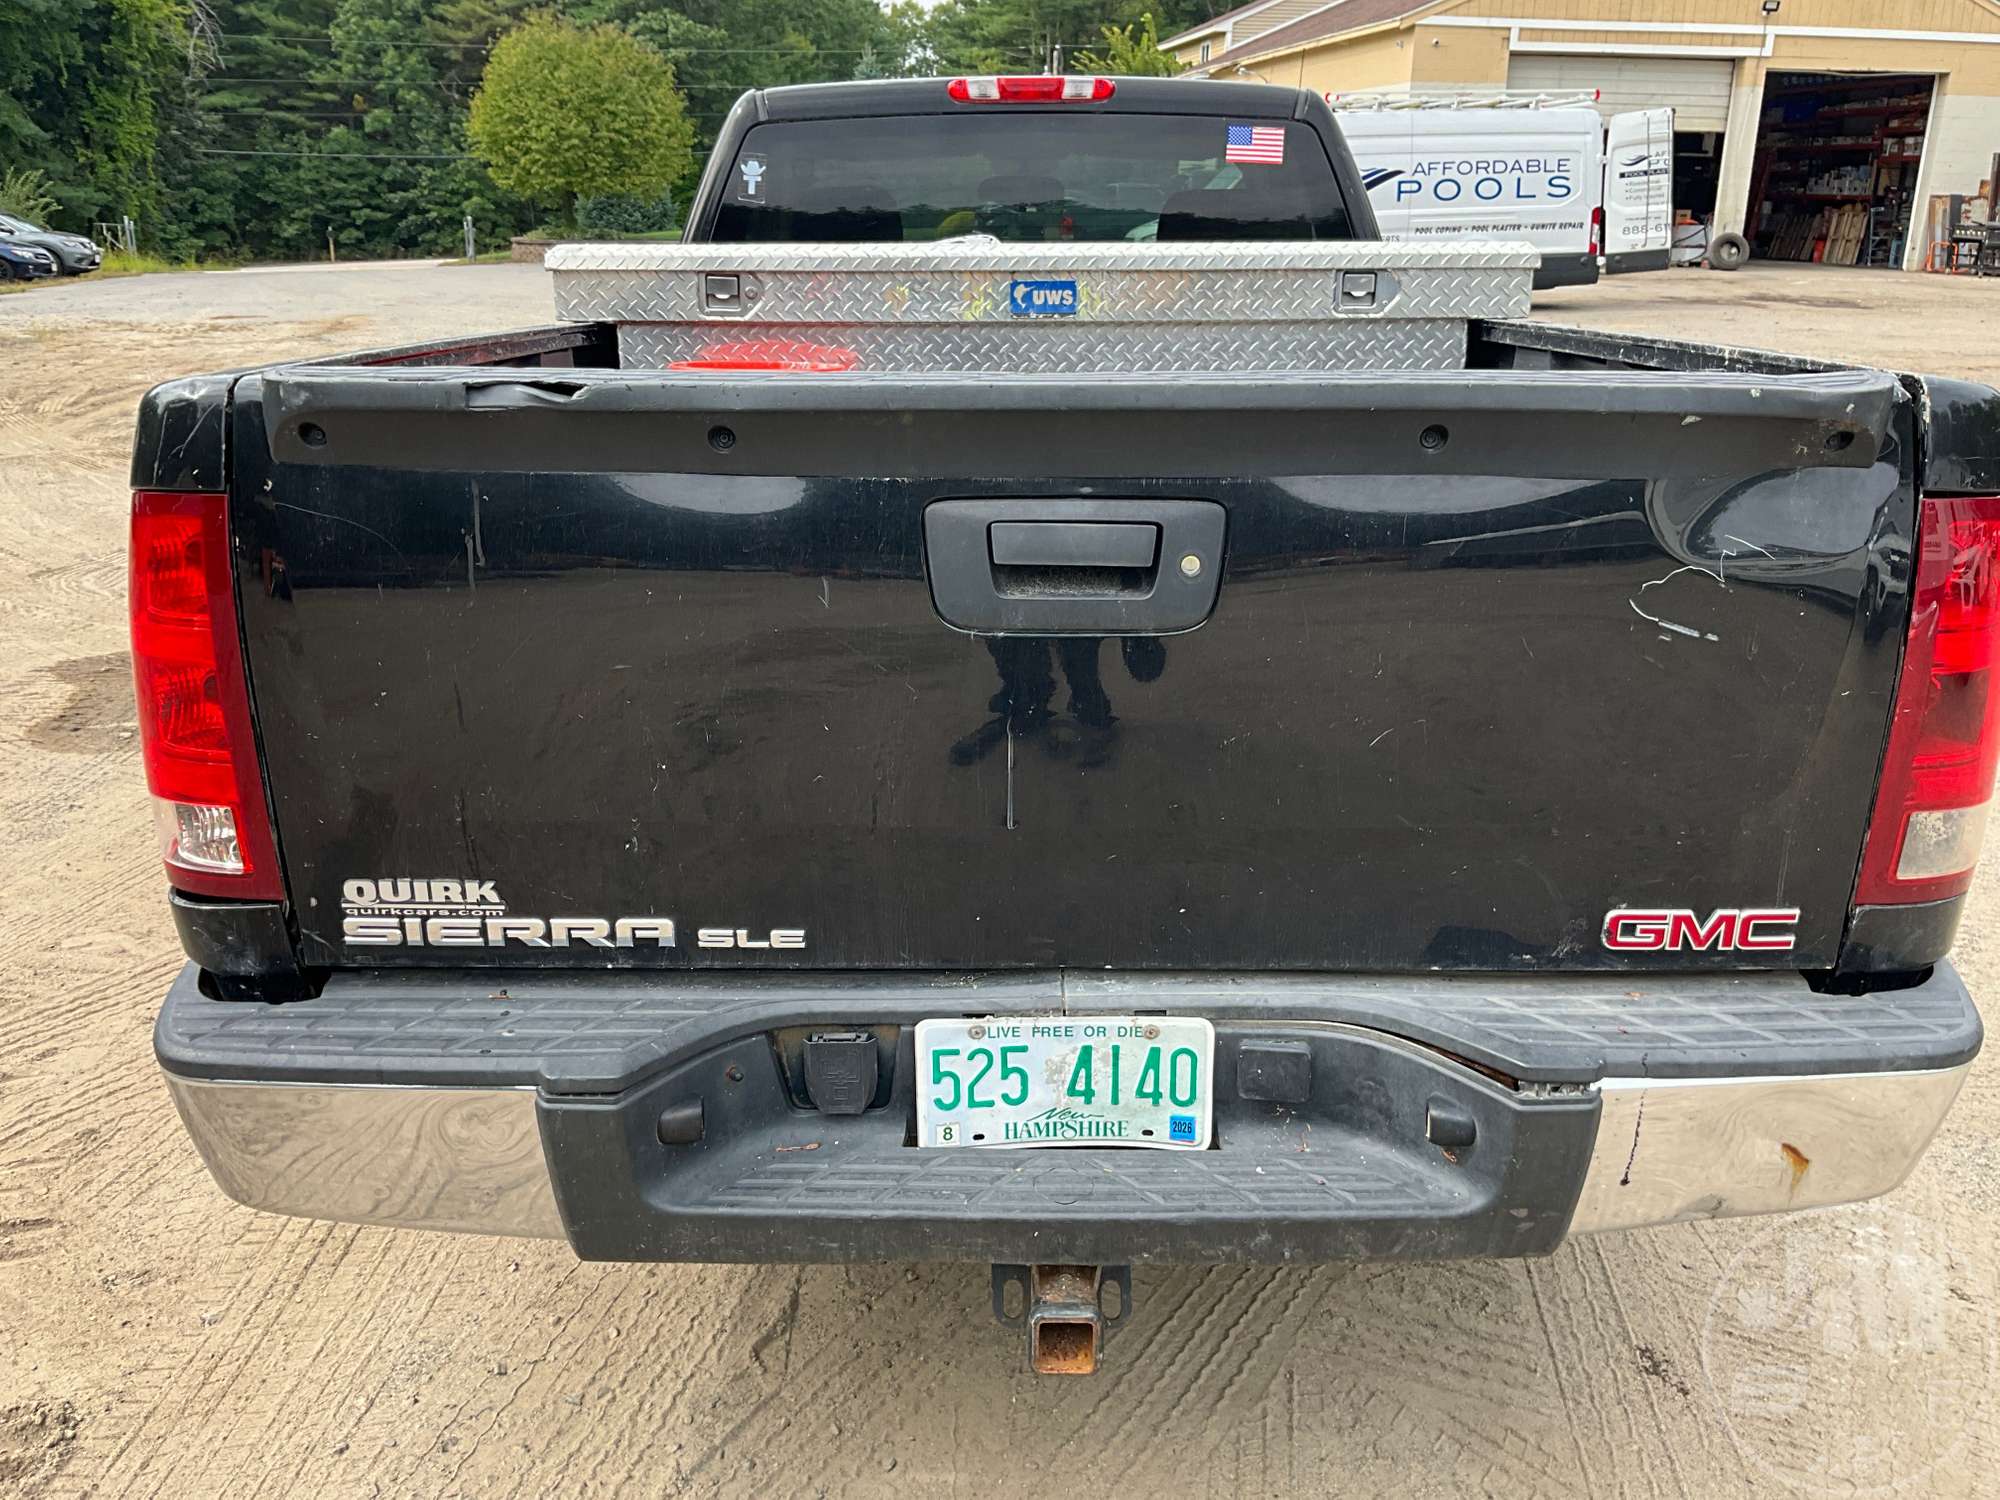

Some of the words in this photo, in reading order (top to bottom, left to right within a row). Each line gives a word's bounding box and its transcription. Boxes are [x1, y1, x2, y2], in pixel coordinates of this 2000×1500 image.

[1412, 158, 1571, 177] AFFORDABLE
[1396, 175, 1571, 202] POOLS
[1415, 226, 1433, 235] POOL
[1471, 224, 1490, 233] POOL
[1491, 223, 1521, 232] PLASTER
[1559, 221, 1585, 230] REPAIR
[1032, 290, 1073, 306] UWS
[343, 878, 501, 906] QUIRK
[345, 907, 504, 917] quirkcars.com
[343, 917, 675, 948] SIERRA
[697, 929, 806, 949] SLE
[1601, 908, 1801, 951] GMC
[987, 1026, 1021, 1039] LIVE
[1031, 1026, 1074, 1038] FREE
[1083, 1026, 1107, 1038] OR
[1117, 1026, 1145, 1038] DIE
[932, 1045, 1029, 1112] 525
[1066, 1044, 1199, 1107] 4140
[1026, 1107, 1105, 1122] New
[942, 1126, 953, 1141] 8
[1004, 1120, 1129, 1141] HAMPSHIRE
[1172, 1121, 1193, 1135] 2026
